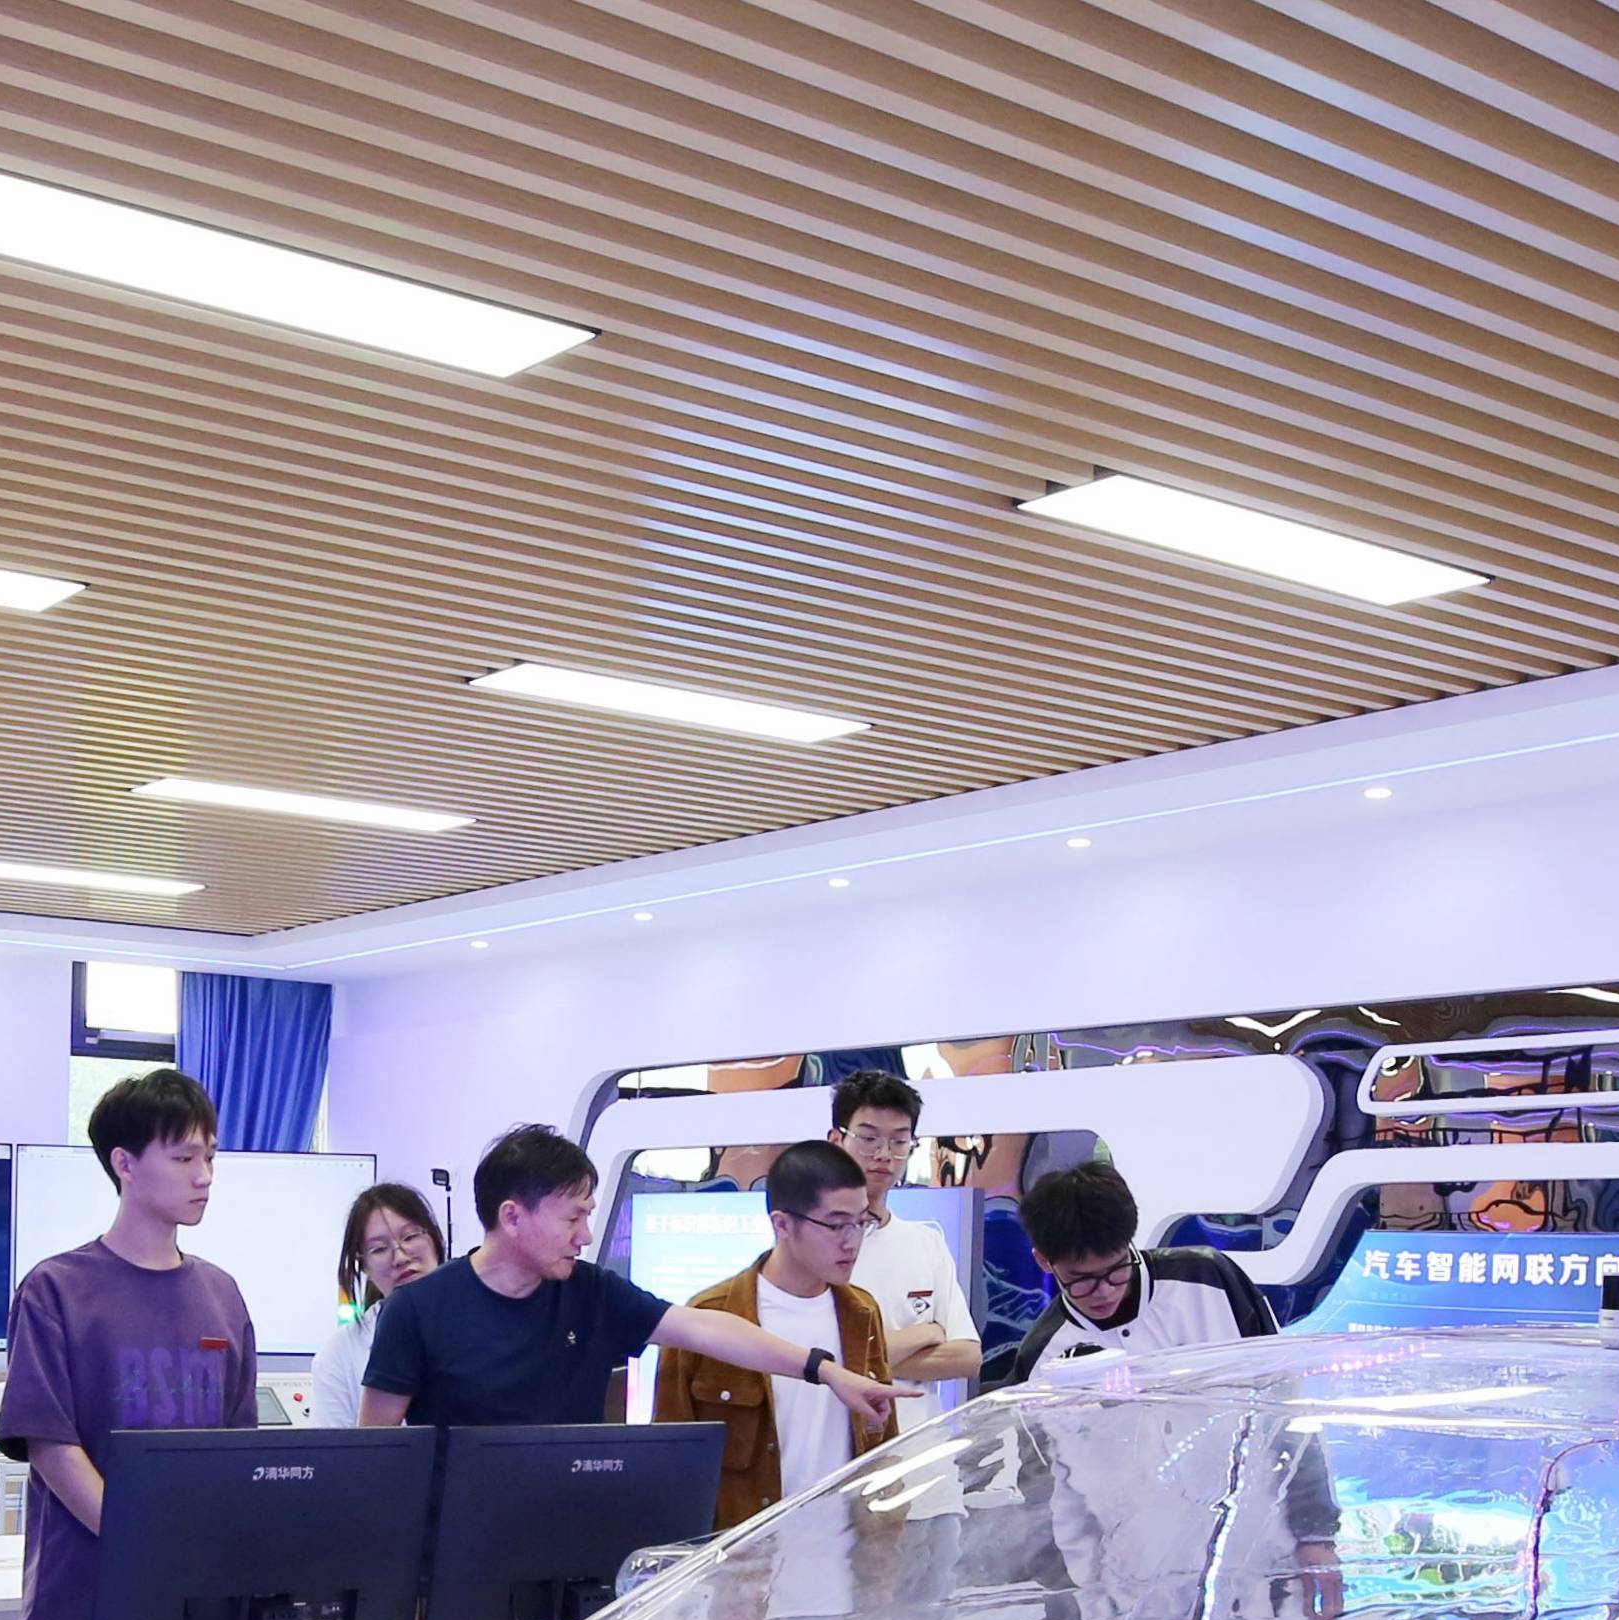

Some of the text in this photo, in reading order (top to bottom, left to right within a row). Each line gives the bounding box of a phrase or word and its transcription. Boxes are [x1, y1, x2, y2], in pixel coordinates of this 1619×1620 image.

[265, 1466, 315, 1480] 清华同方
[582, 1459, 624, 1473] 清华同方
